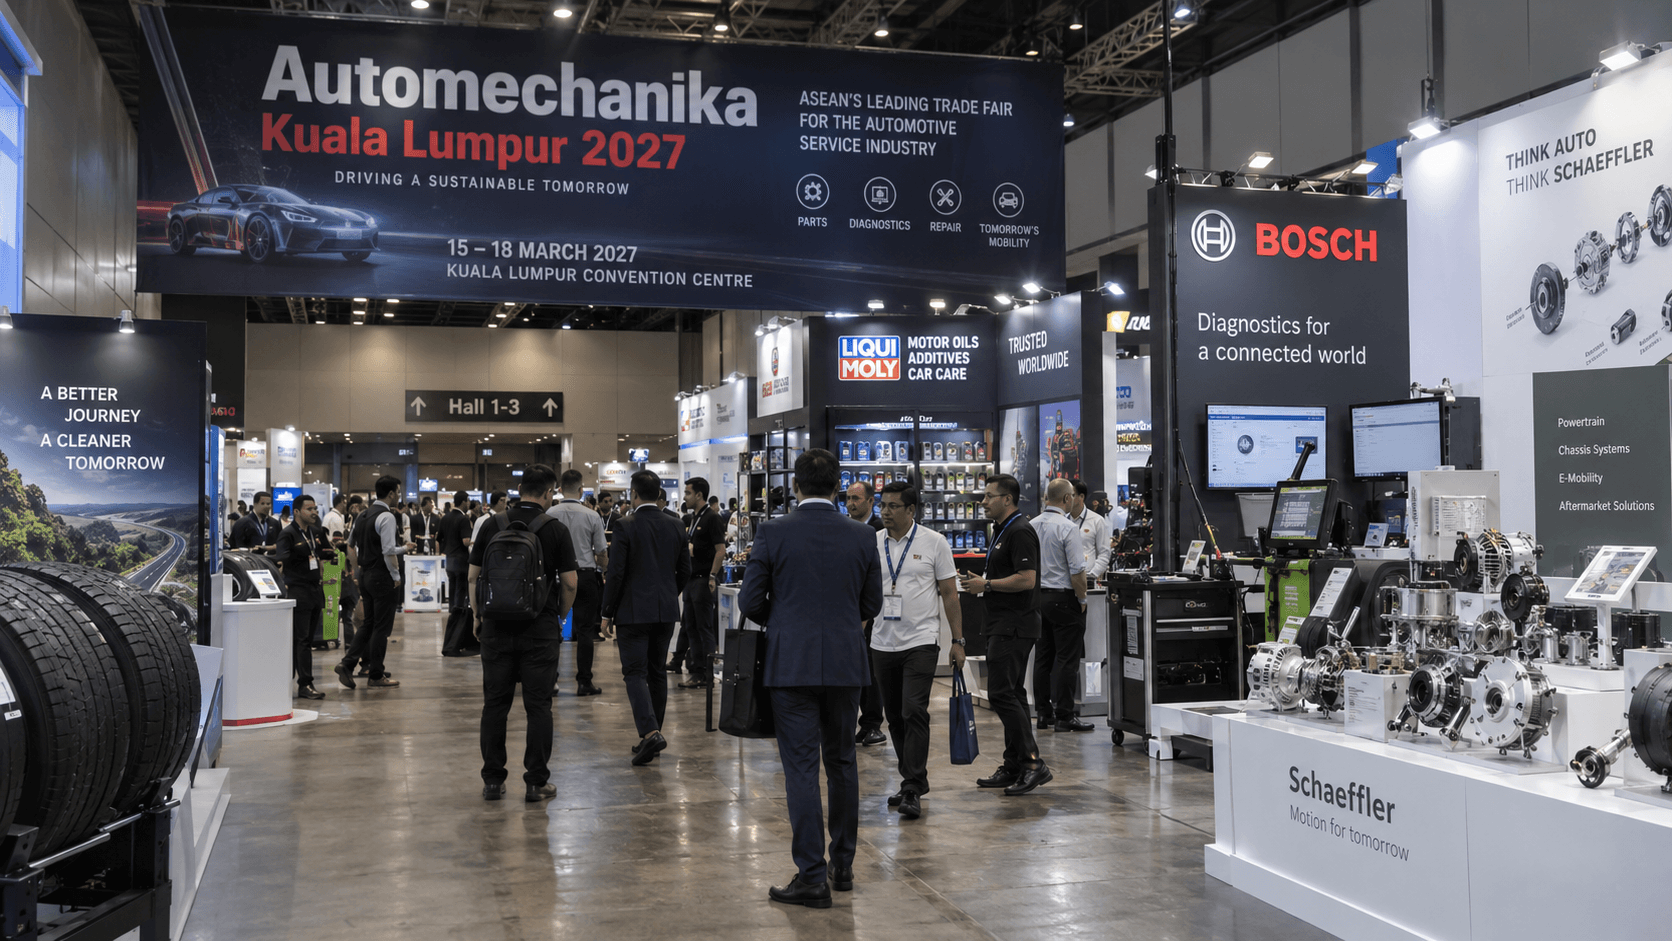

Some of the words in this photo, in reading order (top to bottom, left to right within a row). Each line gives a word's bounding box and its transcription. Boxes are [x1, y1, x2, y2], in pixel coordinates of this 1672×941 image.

[261, 45, 758, 127] Automechanika
[800, 91, 861, 108] ASEAN'S
[868, 94, 928, 111] LEADING
[933, 98, 978, 114] TRADE
[984, 101, 1012, 116] FAIR
[800, 113, 828, 128] FOR
[833, 115, 860, 130] THE
[865, 117, 956, 135] AUTOMOTIVE
[262, 113, 388, 157] Kuala
[404, 119, 568, 170] Lumpur
[582, 130, 685, 169] 2027
[800, 135, 860, 152] SERVICE
[867, 139, 936, 156] INDUSTRY
[1506, 143, 1550, 170] THINK
[1554, 128, 1597, 156] AUTO
[1507, 169, 1549, 195] THINK
[1554, 138, 1654, 183] SCHAEFFLER
[335, 171, 402, 185] DRIVING
[411, 174, 420, 186] A
[429, 175, 534, 191] SUSTAINABLE
[543, 180, 629, 194] TOMORROW
[798, 217, 827, 227] PARTS
[850, 219, 910, 230] DIAGNOSTICS
[930, 222, 961, 232] REPAIR
[979, 224, 1039, 235] TOMORROW'S
[448, 239, 468, 256] 15
[492, 241, 512, 258] 18
[519, 242, 586, 260] MARCH
[594, 245, 637, 262] 2027
[989, 237, 1029, 247] MOBILITY
[1256, 223, 1377, 262] BOSCH
[448, 263, 502, 278] KUALA
[509, 266, 576, 281] LUMPUR
[584, 269, 685, 285] CONVENTION
[693, 273, 752, 287] CENTRE
[1199, 312, 1300, 336] Diagnostics
[1306, 316, 1330, 335] for
[842, 339, 896, 358] LIQUI
[908, 336, 949, 348] MOTOR
[953, 336, 979, 348] OILS
[1009, 331, 1047, 354] TRUSTED
[908, 352, 969, 364] ADDITIVES
[1018, 350, 1068, 375] WORLDWIDE
[1199, 346, 1208, 360] a
[1216, 344, 1311, 363] connected
[1318, 346, 1366, 364] world
[842, 360, 899, 378] MOLY
[908, 368, 932, 380] CAR
[936, 368, 966, 380] CARE
[41, 386, 52, 399] A
[58, 387, 117, 401] BETTER
[449, 398, 484, 414] Hall
[491, 399, 519, 414] 1-3
[65, 409, 140, 422] JOURNEY
[1558, 416, 1604, 427] Powertrain
[40, 434, 52, 447] A
[57, 434, 131, 447] CLEANER
[1559, 445, 1591, 455] Chassis
[1594, 444, 1630, 456] Systems
[65, 456, 165, 470] TOMORROW
[1559, 473, 1603, 484] E-Mobility
[1559, 501, 1611, 510] Aftermarket
[1614, 501, 1654, 510] Solutions
[1289, 766, 1395, 823] Schaeffler
[1290, 805, 1326, 832] Motion
[1330, 818, 1346, 838] for
[1350, 826, 1409, 861] tomorrow
